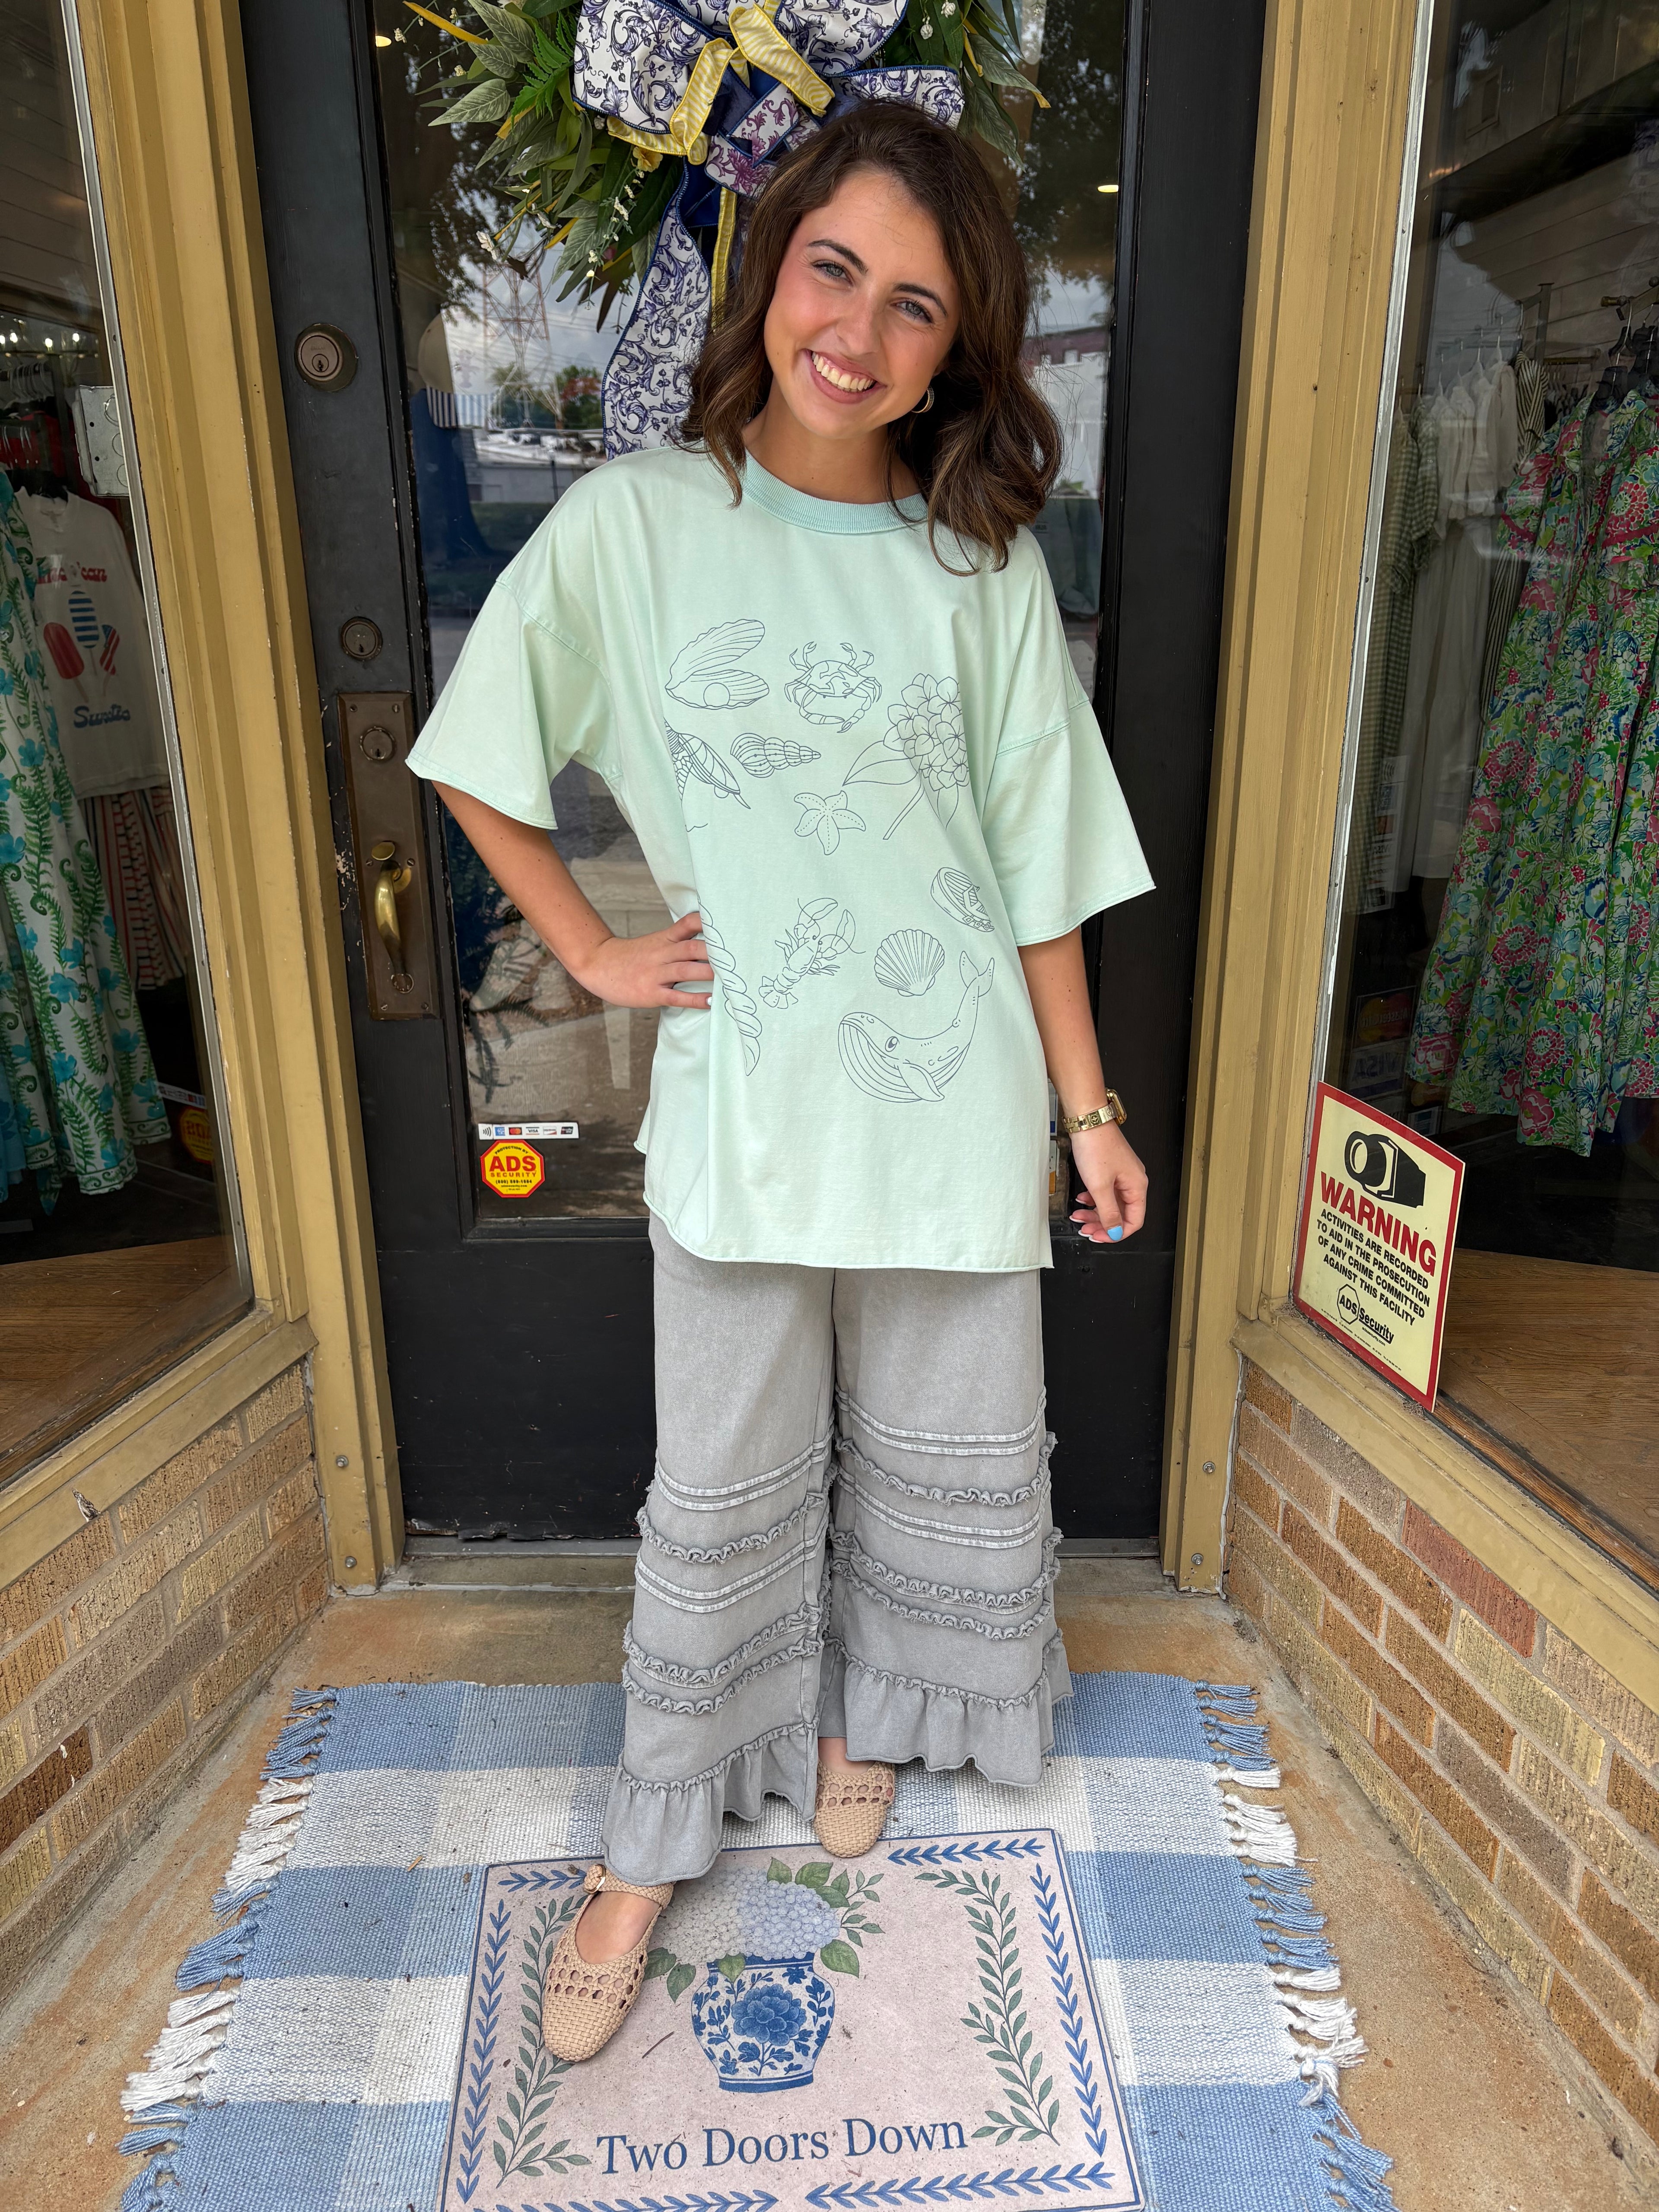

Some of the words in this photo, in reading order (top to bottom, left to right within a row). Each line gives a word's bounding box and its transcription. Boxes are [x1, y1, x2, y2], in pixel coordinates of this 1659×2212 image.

[489, 1156, 536, 1172] ADS
[495, 1146, 521, 1154] PROTECTION
[1321, 1171, 1437, 1277] WARNING
[1321, 1208, 1364, 1243] ACTIVITIES
[1365, 1237, 1382, 1256] ARE
[1383, 1249, 1429, 1289] RECORDED
[1317, 1219, 1328, 1233] TO
[1328, 1228, 1343, 1243] AID
[1344, 1237, 1353, 1252] IN
[1355, 1244, 1371, 1264] THE
[1373, 1257, 1430, 1307] PROSECUTION
[1318, 1235, 1329, 1248] OF
[1330, 1243, 1347, 1261] ANY
[1348, 1255, 1374, 1281] CRIME
[1376, 1275, 1425, 1318] COMMITTED
[1323, 1254, 1358, 1284] AGAINST
[1360, 1278, 1378, 1299] THIS
[1379, 1292, 1416, 1326] FACILITY
[1339, 1294, 1357, 1315] ADS
[1359, 1307, 1395, 1342] Security
[596, 2133, 687, 2175] Two
[702, 2127, 830, 2167] Doors
[842, 2117, 969, 2157] Down
